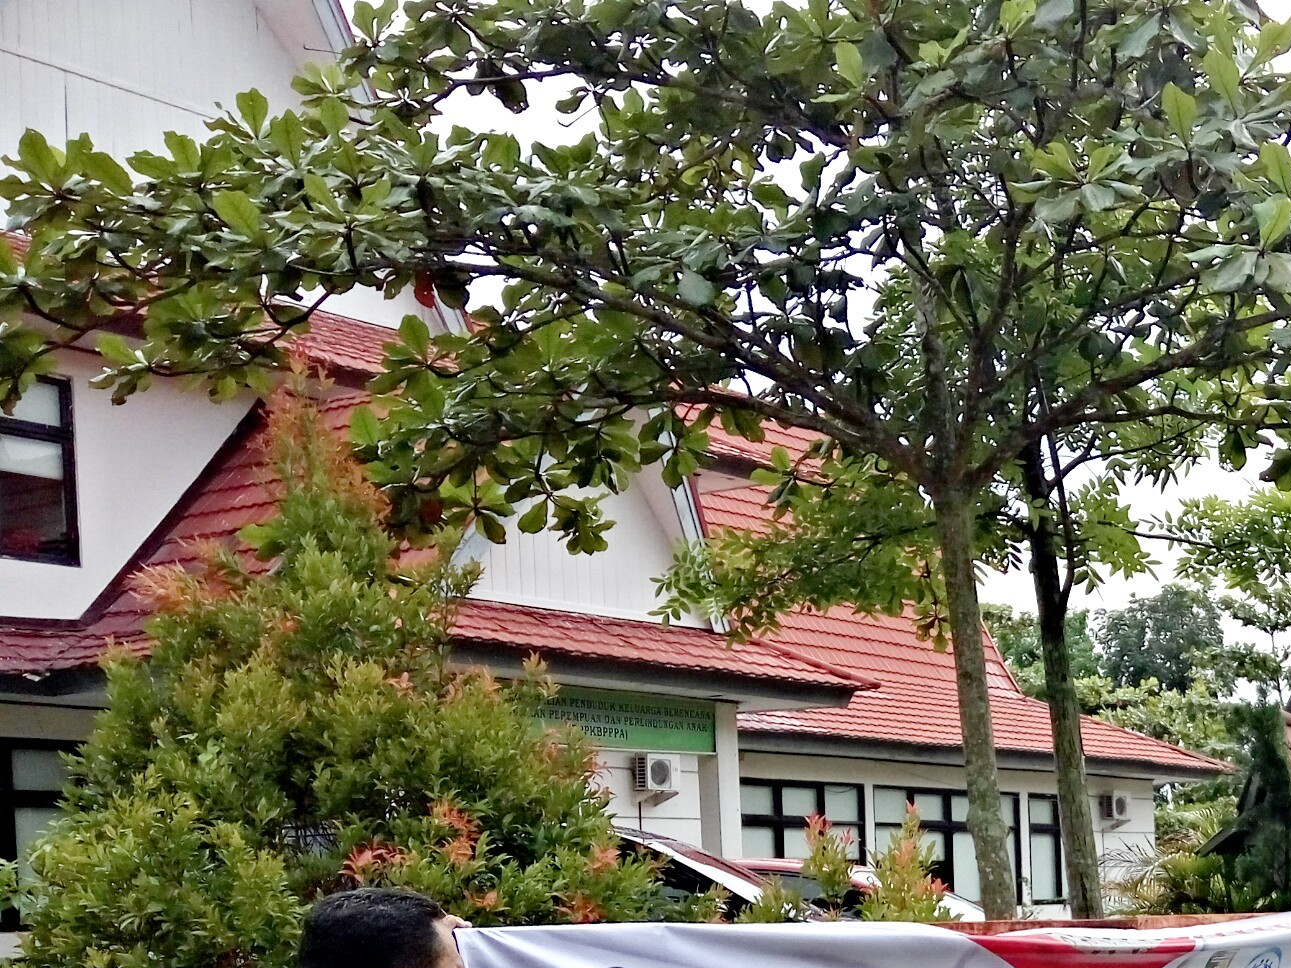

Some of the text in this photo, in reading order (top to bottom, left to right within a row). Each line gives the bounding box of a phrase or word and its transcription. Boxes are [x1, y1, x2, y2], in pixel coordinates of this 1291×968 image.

[570, 699, 616, 712] PENDUDUK
[619, 703, 662, 716] KELUARGA
[549, 709, 602, 723] PEREMPUAN
[604, 714, 621, 725] DAN
[624, 716, 685, 731] PERLINDUNGAN
[687, 722, 708, 733] ANAK
